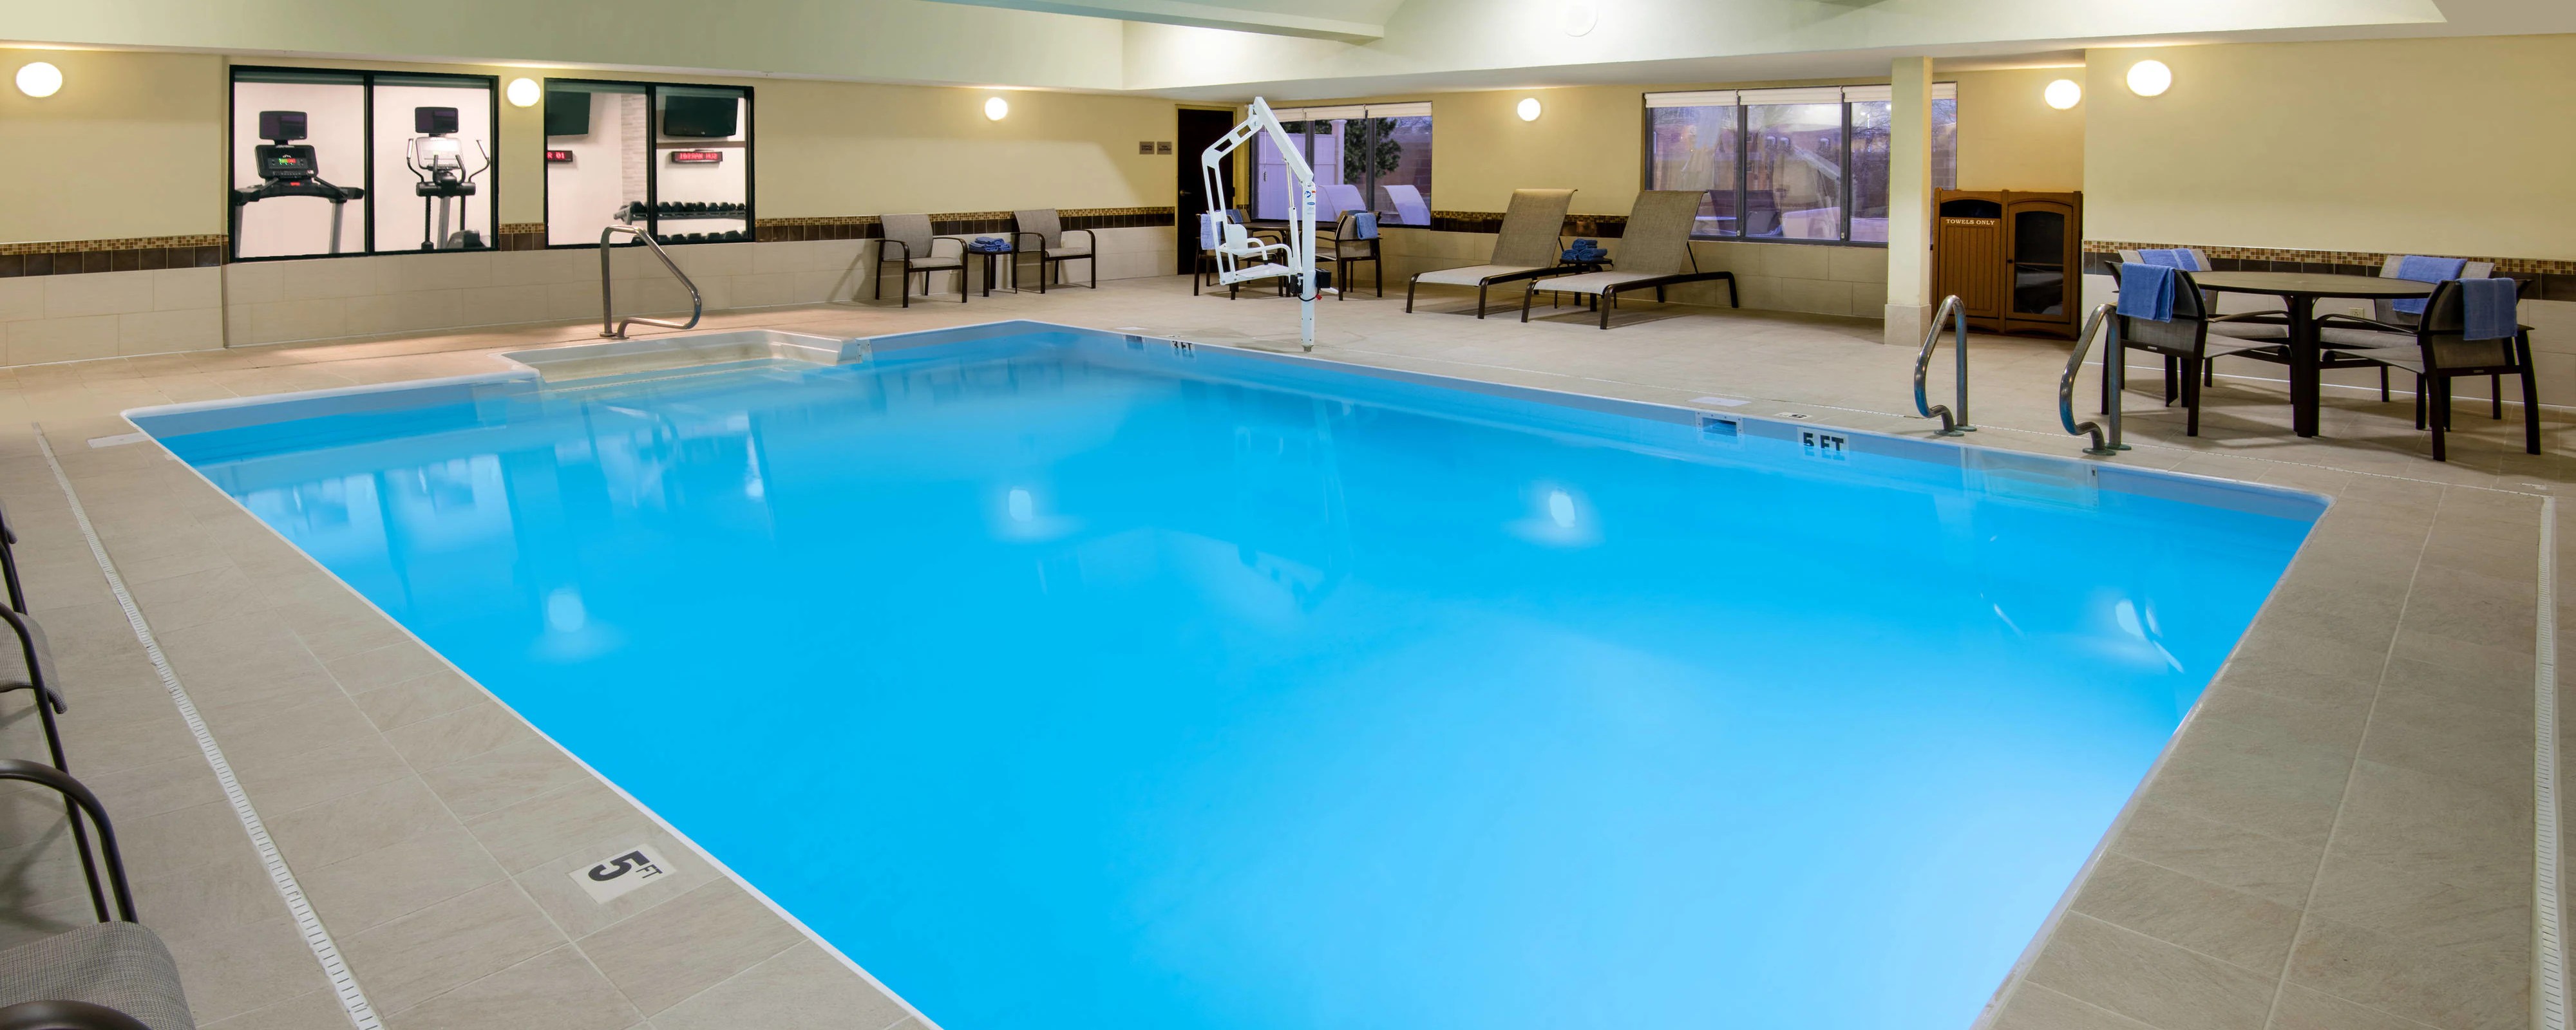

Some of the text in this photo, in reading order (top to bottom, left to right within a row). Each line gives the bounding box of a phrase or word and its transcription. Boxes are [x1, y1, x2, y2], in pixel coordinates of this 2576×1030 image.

[1180, 342, 1192, 351] FT
[1803, 432, 1844, 451] 5 FT
[588, 850, 663, 881] 5 FT
